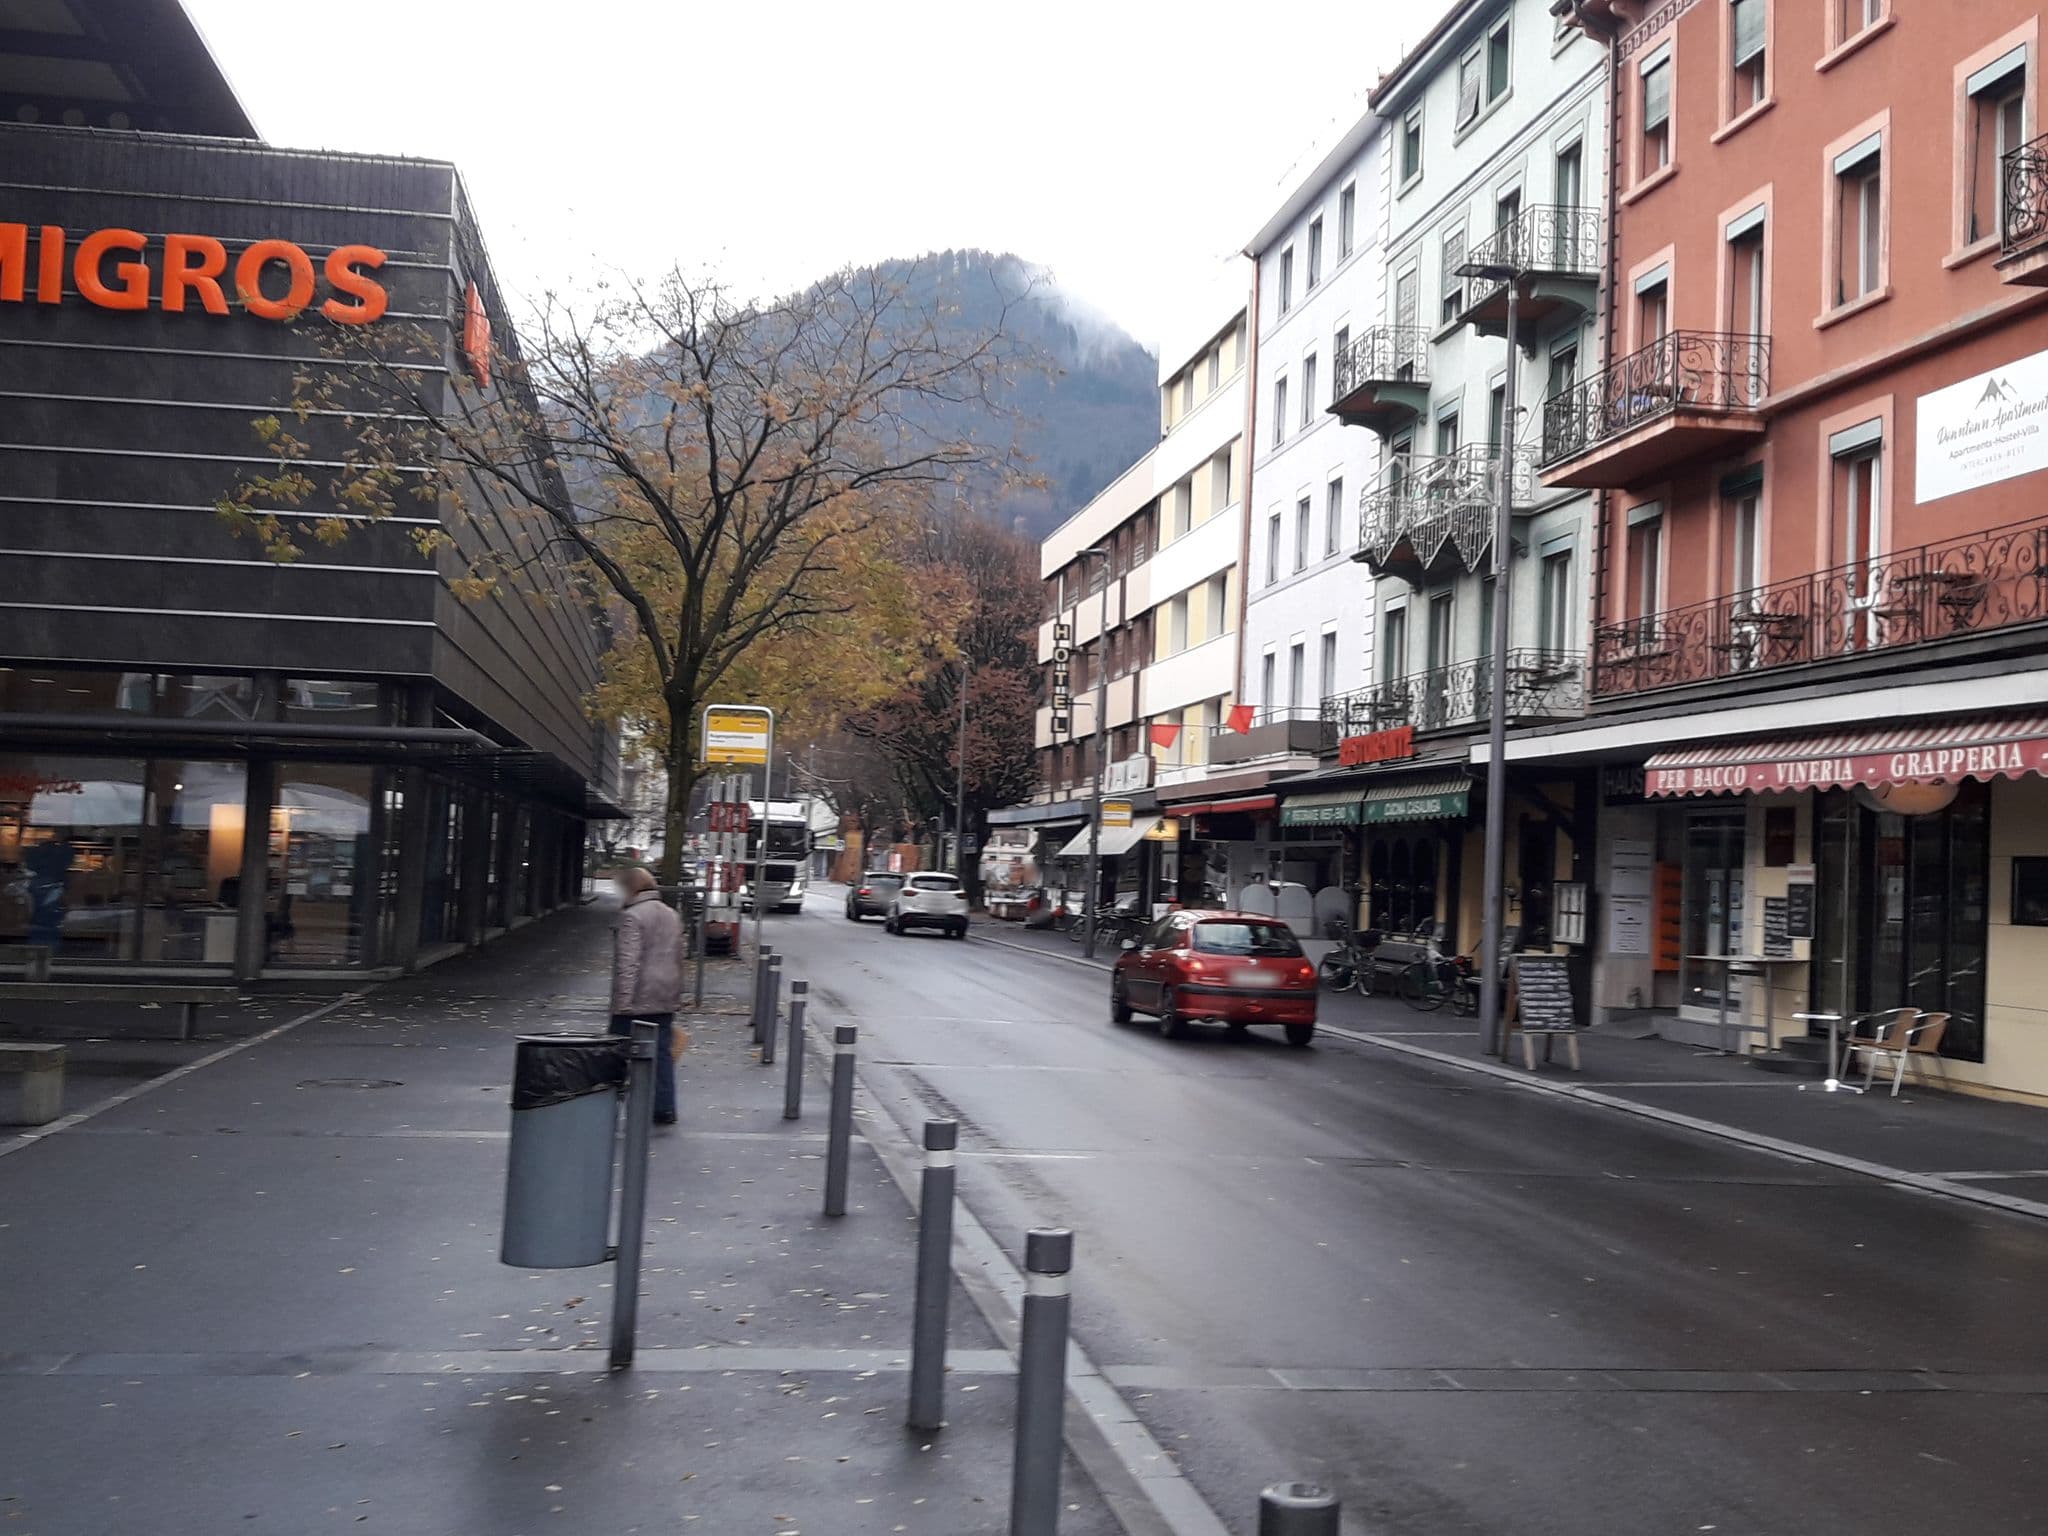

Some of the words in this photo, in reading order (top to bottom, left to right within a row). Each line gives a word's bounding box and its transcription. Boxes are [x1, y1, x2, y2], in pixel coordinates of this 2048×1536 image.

[1052, 624, 1070, 732] HOTEL
[1657, 769, 1686, 789] PER
[1693, 765, 1747, 788] BACCO
[1776, 757, 1854, 784] VINERIA
[1890, 743, 2024, 778] GRAPPERIA
